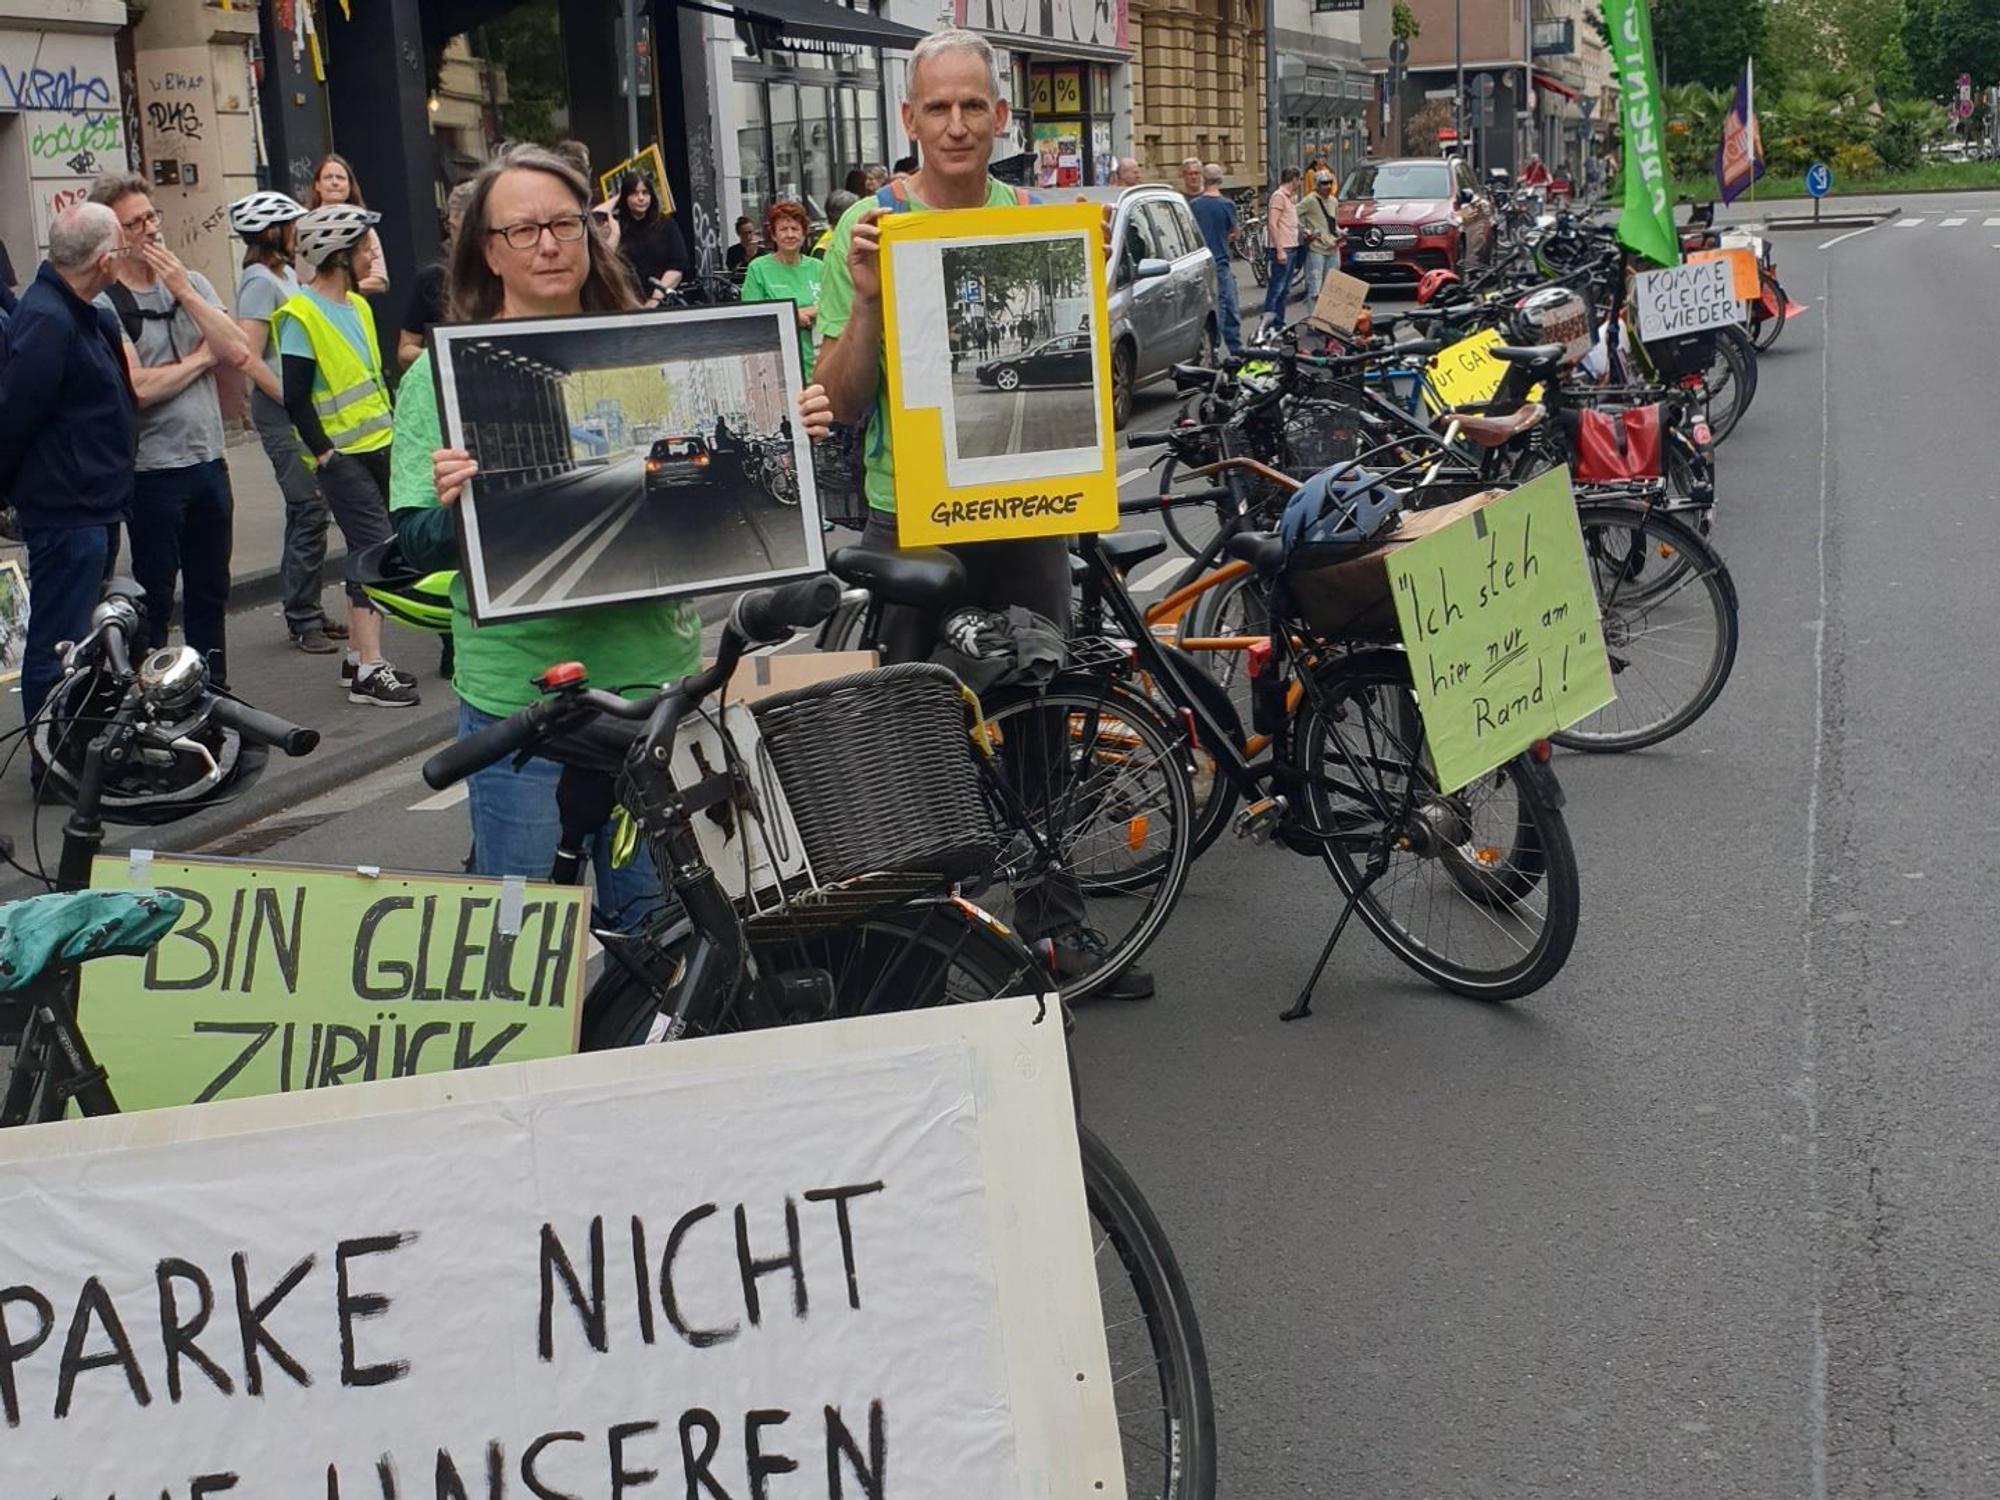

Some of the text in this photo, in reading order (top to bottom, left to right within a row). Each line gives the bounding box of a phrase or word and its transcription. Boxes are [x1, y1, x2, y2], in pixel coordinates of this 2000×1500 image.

[1647, 260, 1724, 293] KOMME
[1654, 283, 1725, 312] GLEICH
[930, 491, 1084, 527] GREENPEACE
[1479, 511, 1540, 608] steh
[1428, 601, 1569, 697] hier nur am
[144, 886, 581, 1007] BIN GLEICH
[192, 1012, 527, 1104] ZURÜCK
[0, 1179, 886, 1428] PARKE NICHT
[327, 1399, 888, 1500] SEREN
